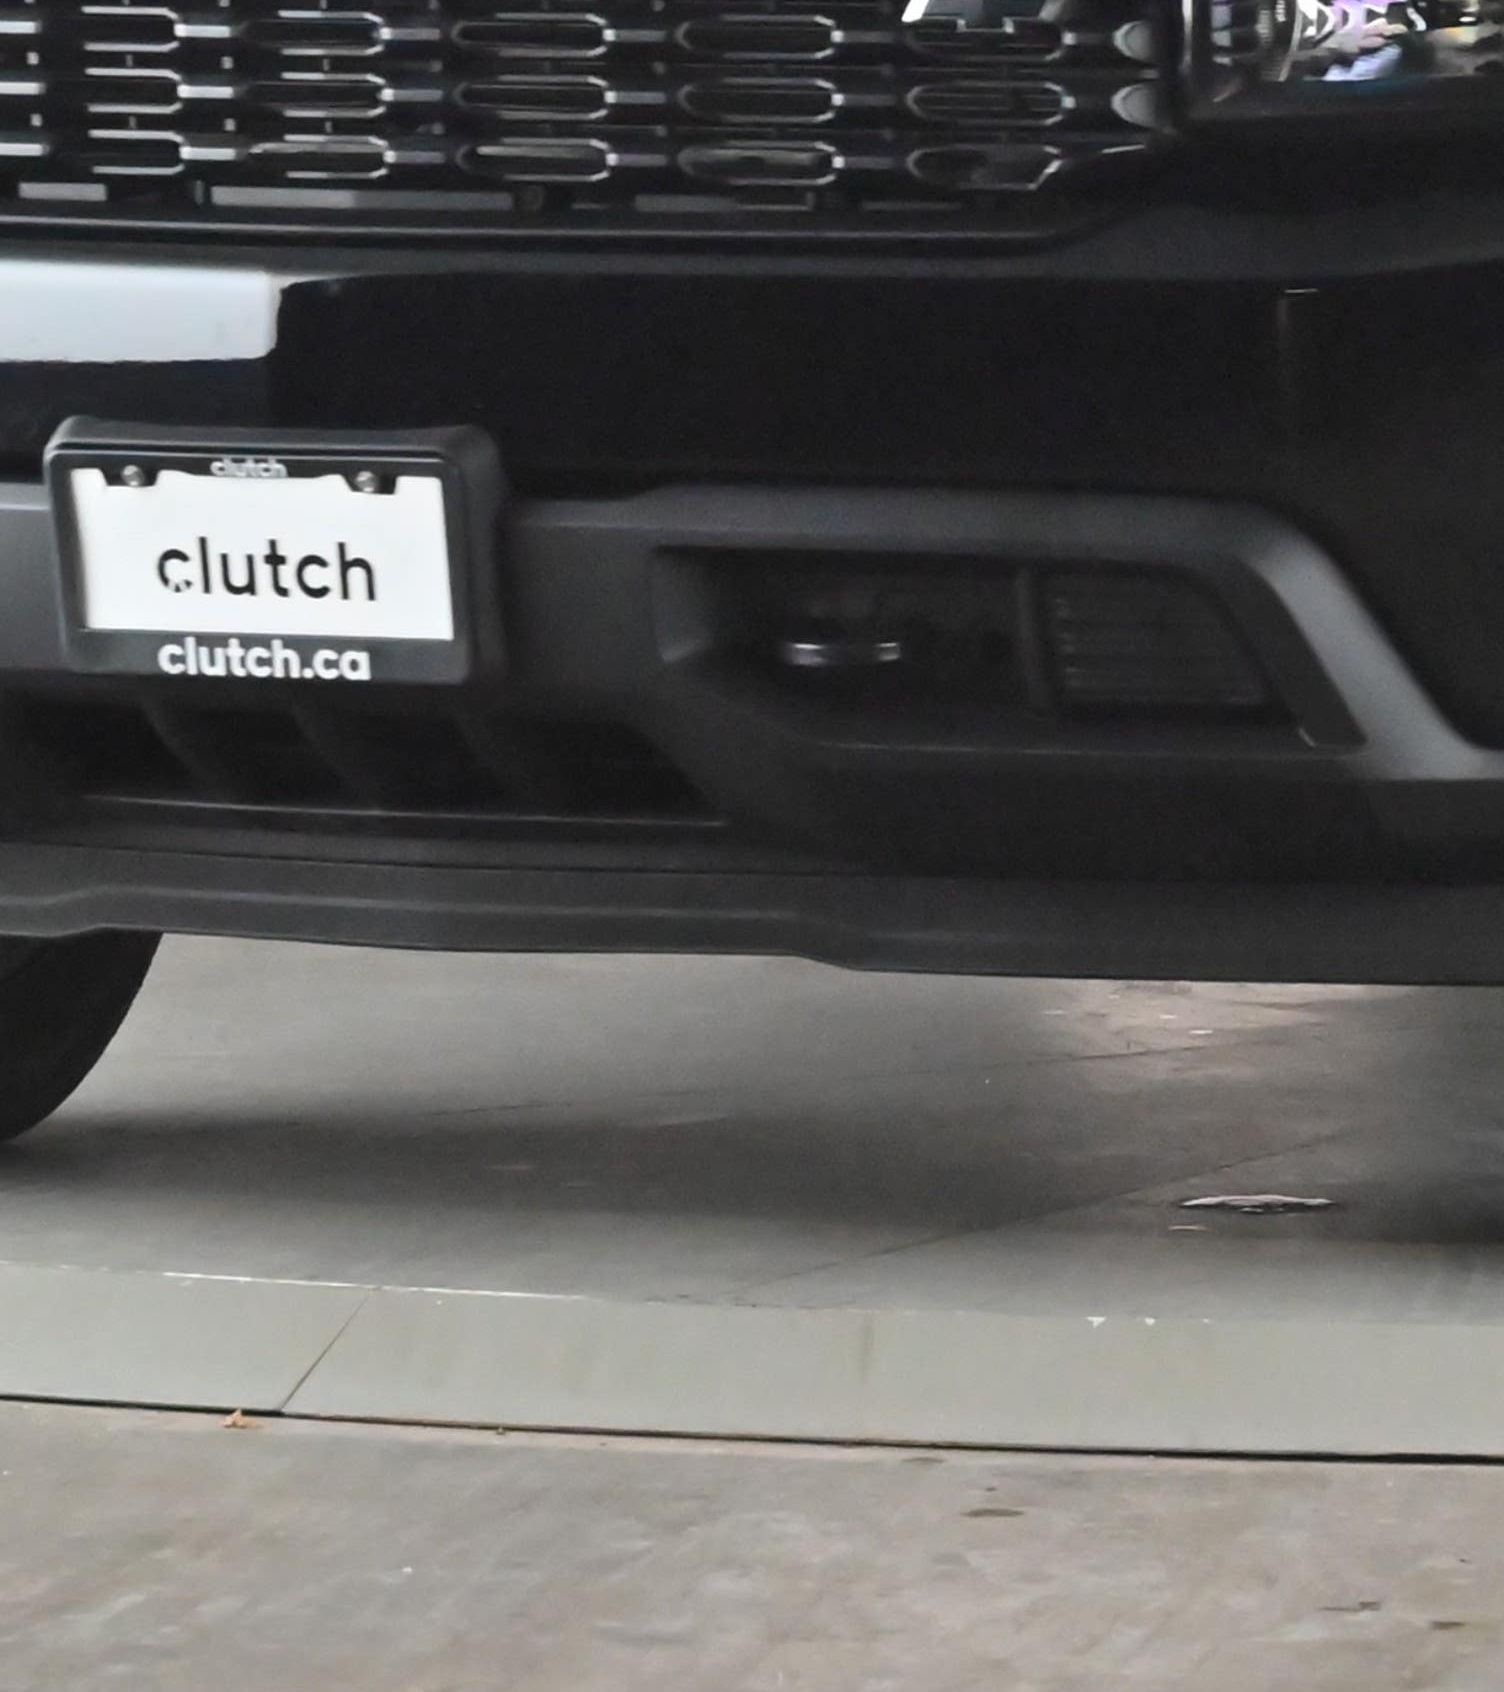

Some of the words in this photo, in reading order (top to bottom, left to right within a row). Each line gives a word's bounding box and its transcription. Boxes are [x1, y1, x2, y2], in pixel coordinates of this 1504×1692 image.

[209, 457, 289, 478] clutch
[157, 537, 375, 601] clutch
[157, 636, 371, 681] clutch.ca
